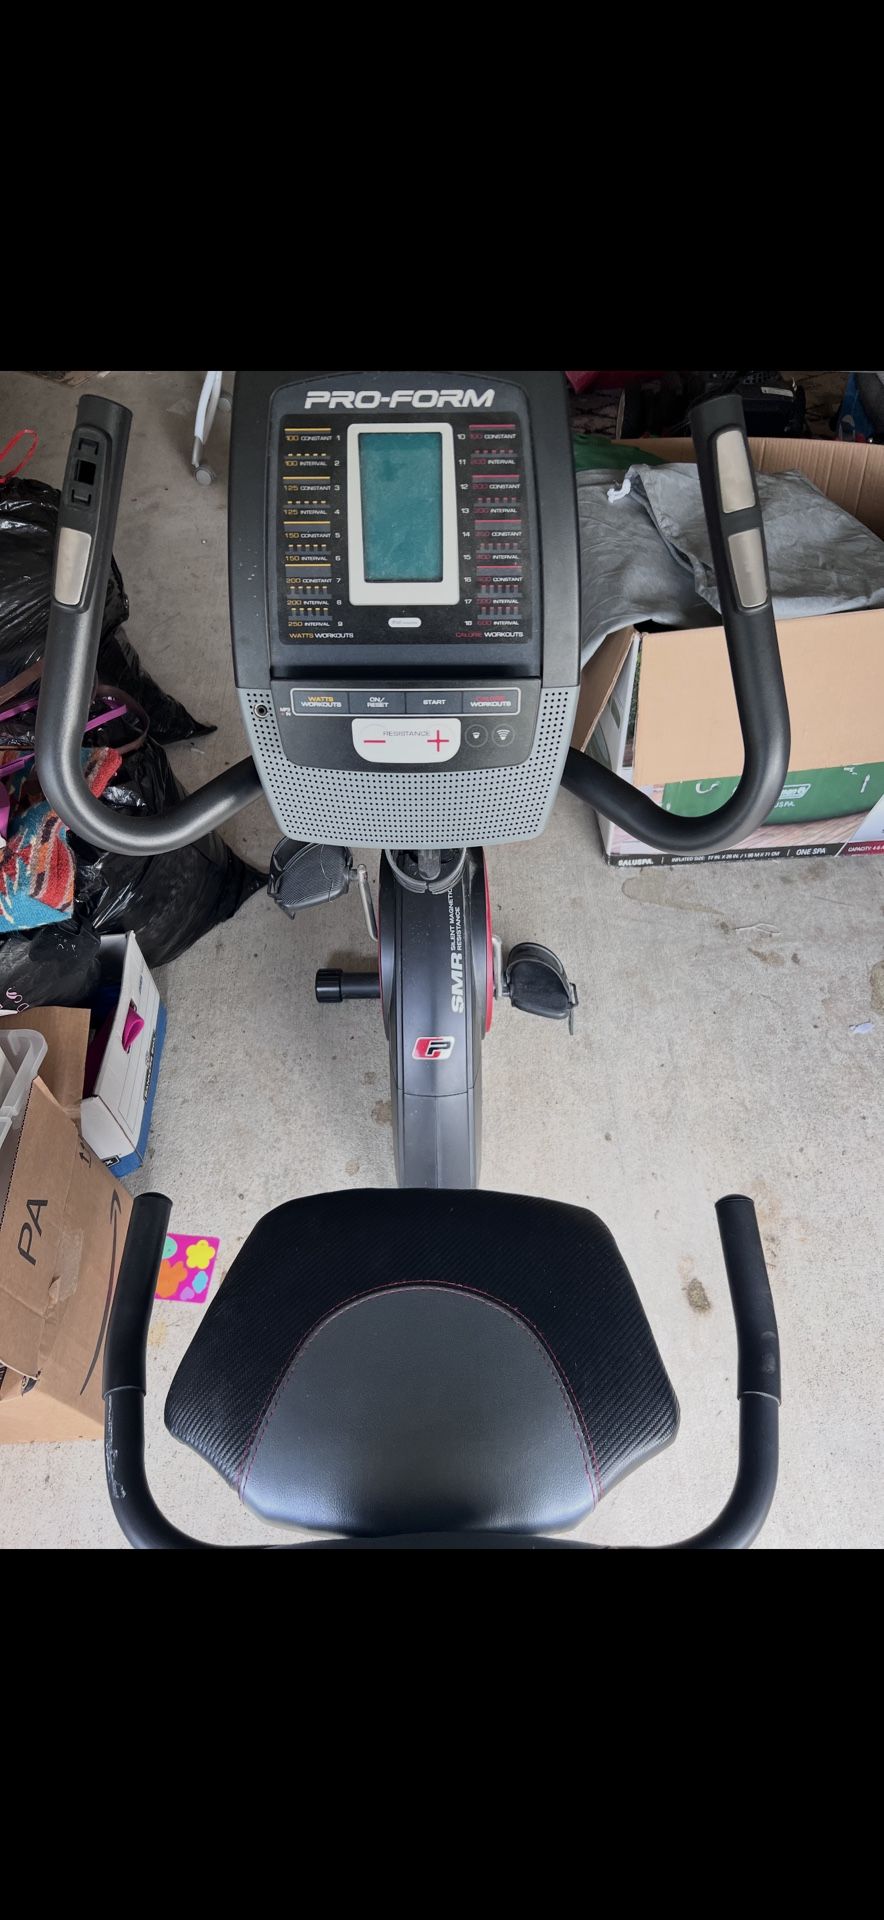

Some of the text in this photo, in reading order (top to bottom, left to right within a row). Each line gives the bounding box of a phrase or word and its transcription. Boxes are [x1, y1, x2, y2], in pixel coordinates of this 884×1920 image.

[304, 388, 496, 409] PRO-FORM
[454, 906, 462, 951] RESISTANCE
[451, 952, 464, 1014] SMR
[17, 1199, 48, 1267] PA
